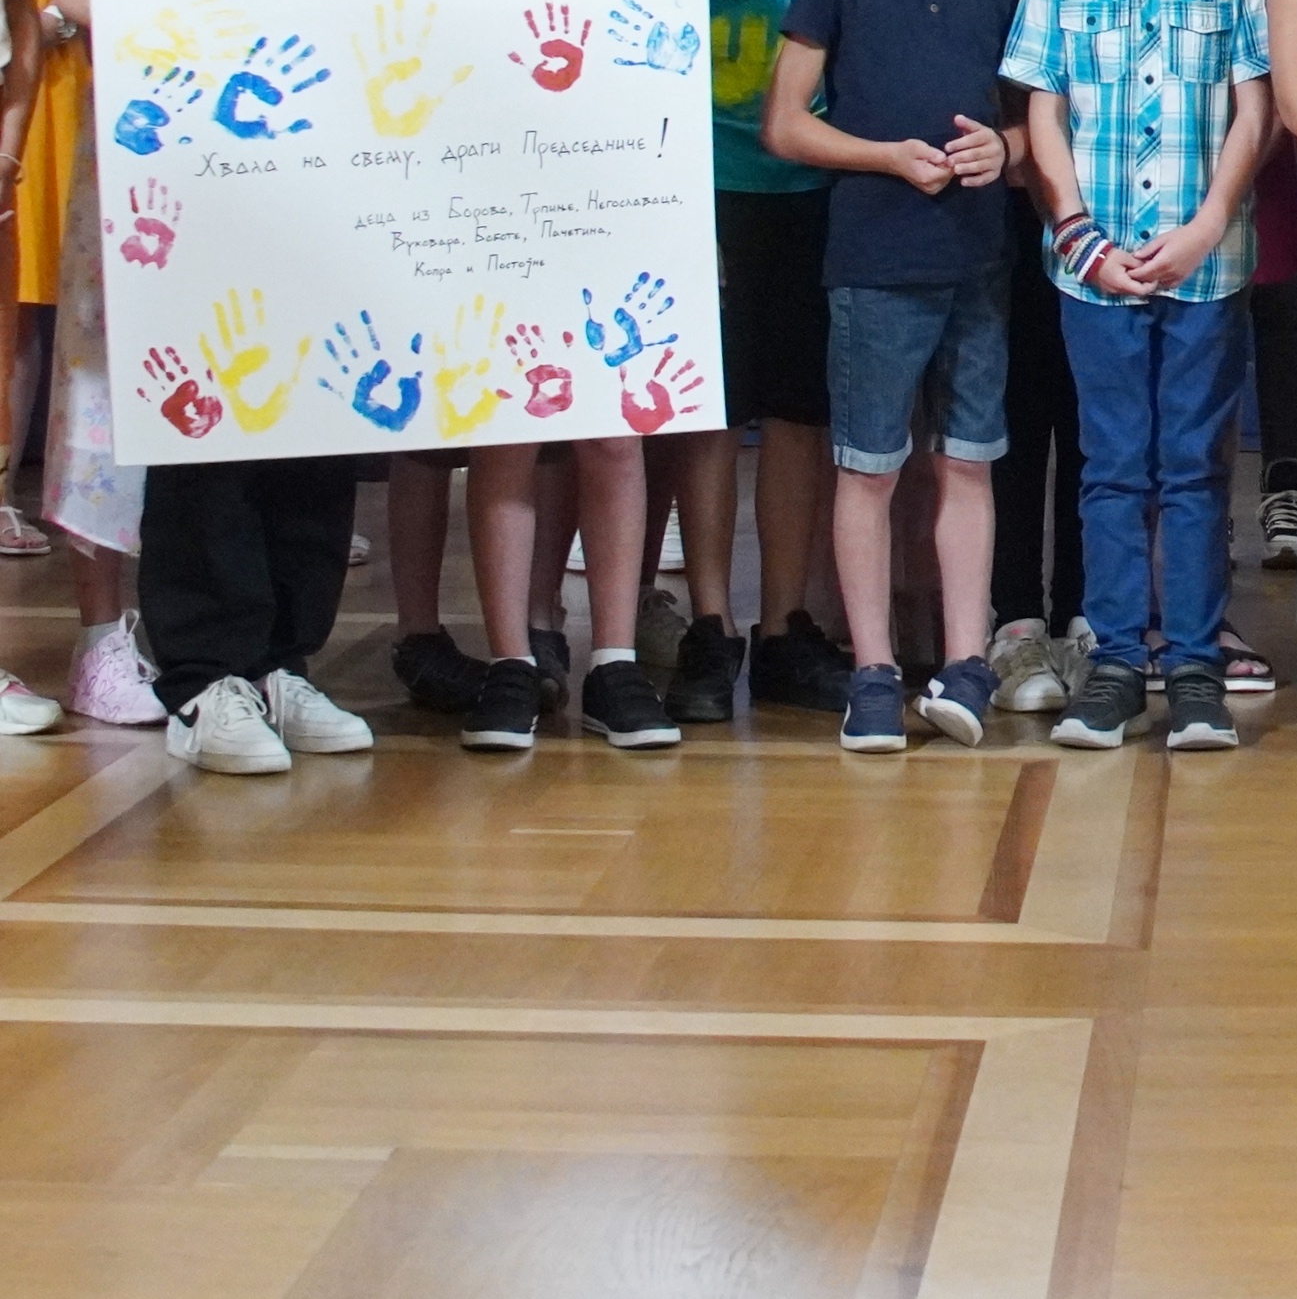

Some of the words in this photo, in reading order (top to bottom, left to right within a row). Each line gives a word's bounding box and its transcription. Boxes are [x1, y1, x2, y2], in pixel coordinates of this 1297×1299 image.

[194, 151, 278, 178] Хвала
[302, 156, 327, 168] на
[441, 141, 502, 173] драги
[354, 212, 397, 230] деца
[412, 210, 430, 222] из
[413, 261, 453, 282] Копра
[466, 265, 475, 274] и
[487, 253, 546, 279] Постојне
